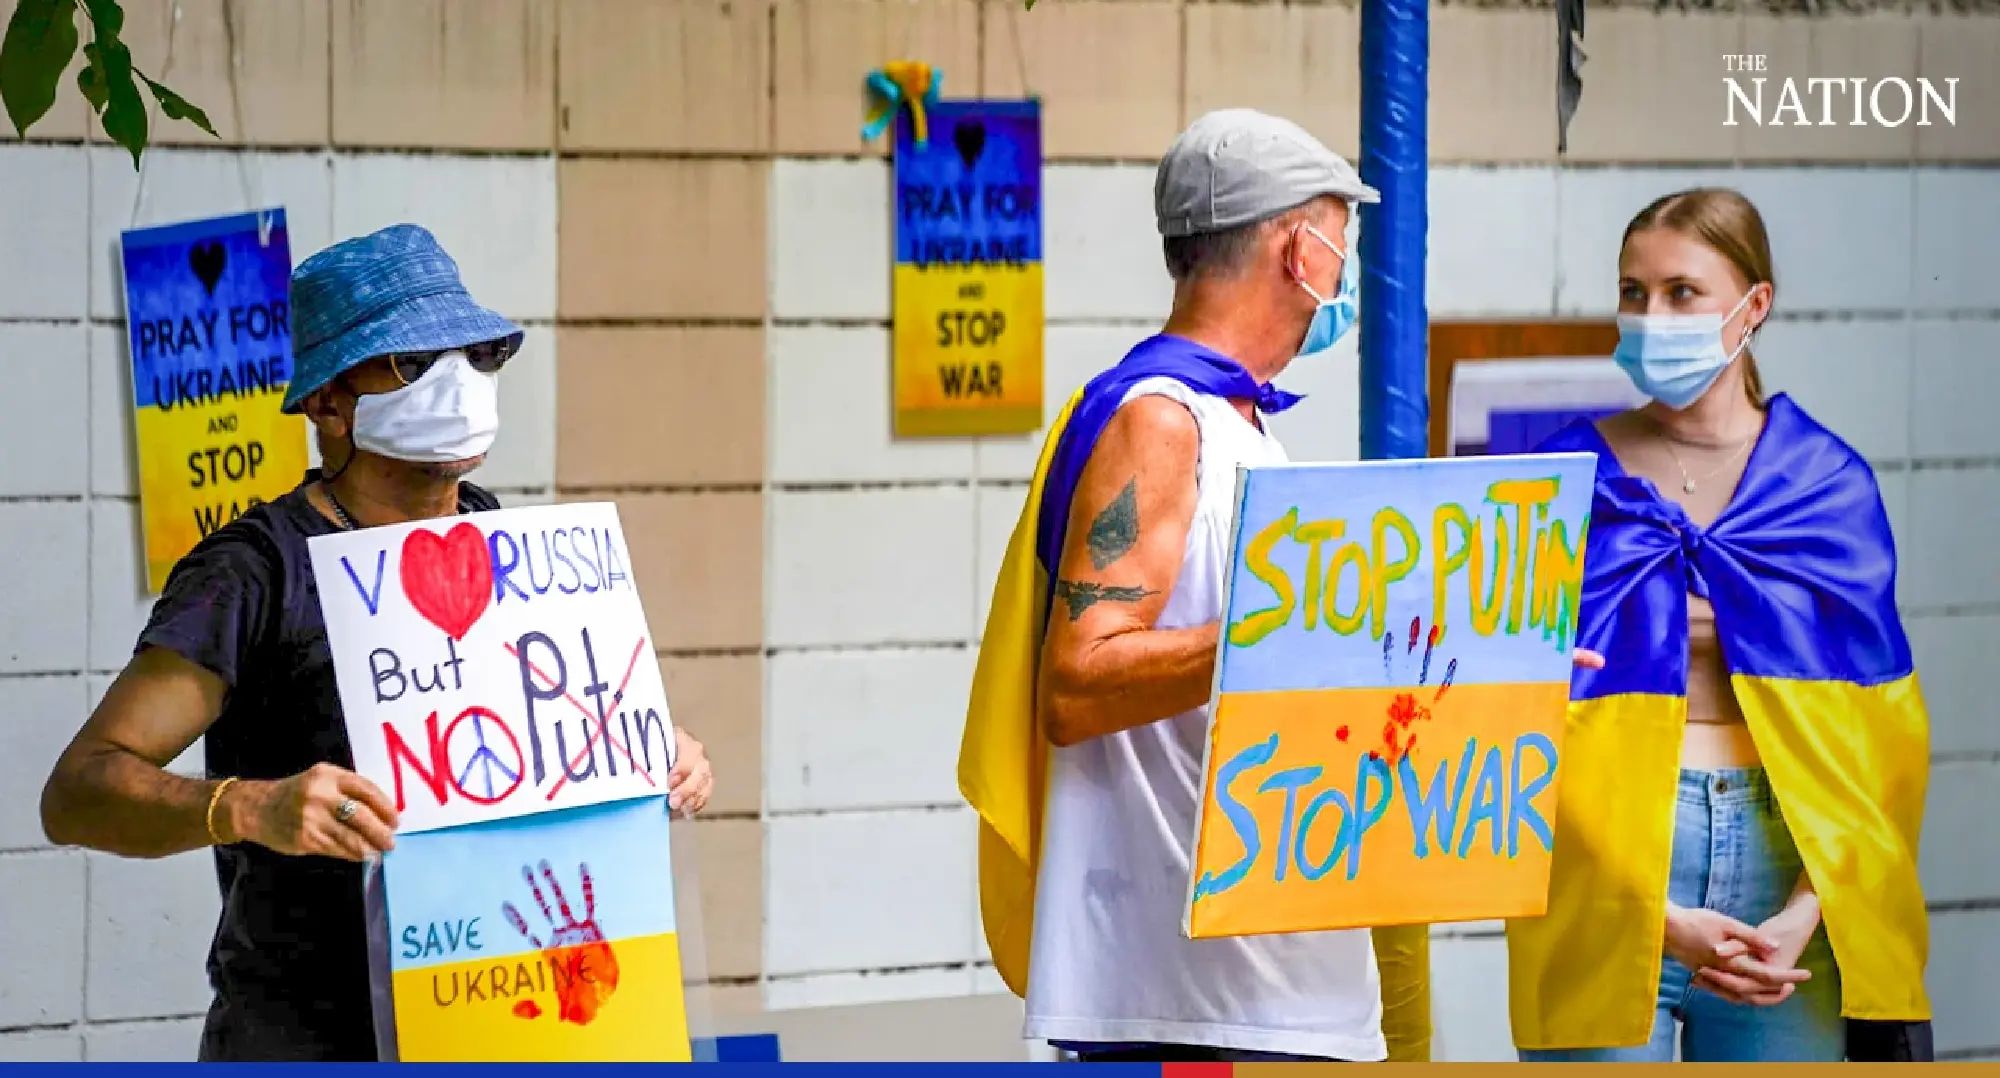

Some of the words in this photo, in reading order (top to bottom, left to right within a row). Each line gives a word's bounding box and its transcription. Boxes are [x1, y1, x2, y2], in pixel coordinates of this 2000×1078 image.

[903, 183, 977, 223] PRAY
[983, 183, 1036, 221] FOR
[139, 304, 219, 360] PRAY
[229, 299, 290, 345] FOR
[937, 310, 1006, 348] STOP
[153, 353, 285, 412] UKRAINE
[938, 361, 1004, 400] WAR
[207, 414, 238, 434] AND
[188, 441, 264, 489] STOP
[340, 549, 387, 616] V
[487, 525, 632, 606] RUSSIA
[1226, 506, 1422, 648] STOP
[369, 636, 465, 704] But
[516, 626, 677, 788] Putin
[1193, 733, 1394, 902] STOP
[1398, 732, 1560, 860] WAR
[402, 916, 484, 959] SAVE
[432, 954, 597, 1008] UKRAINE
